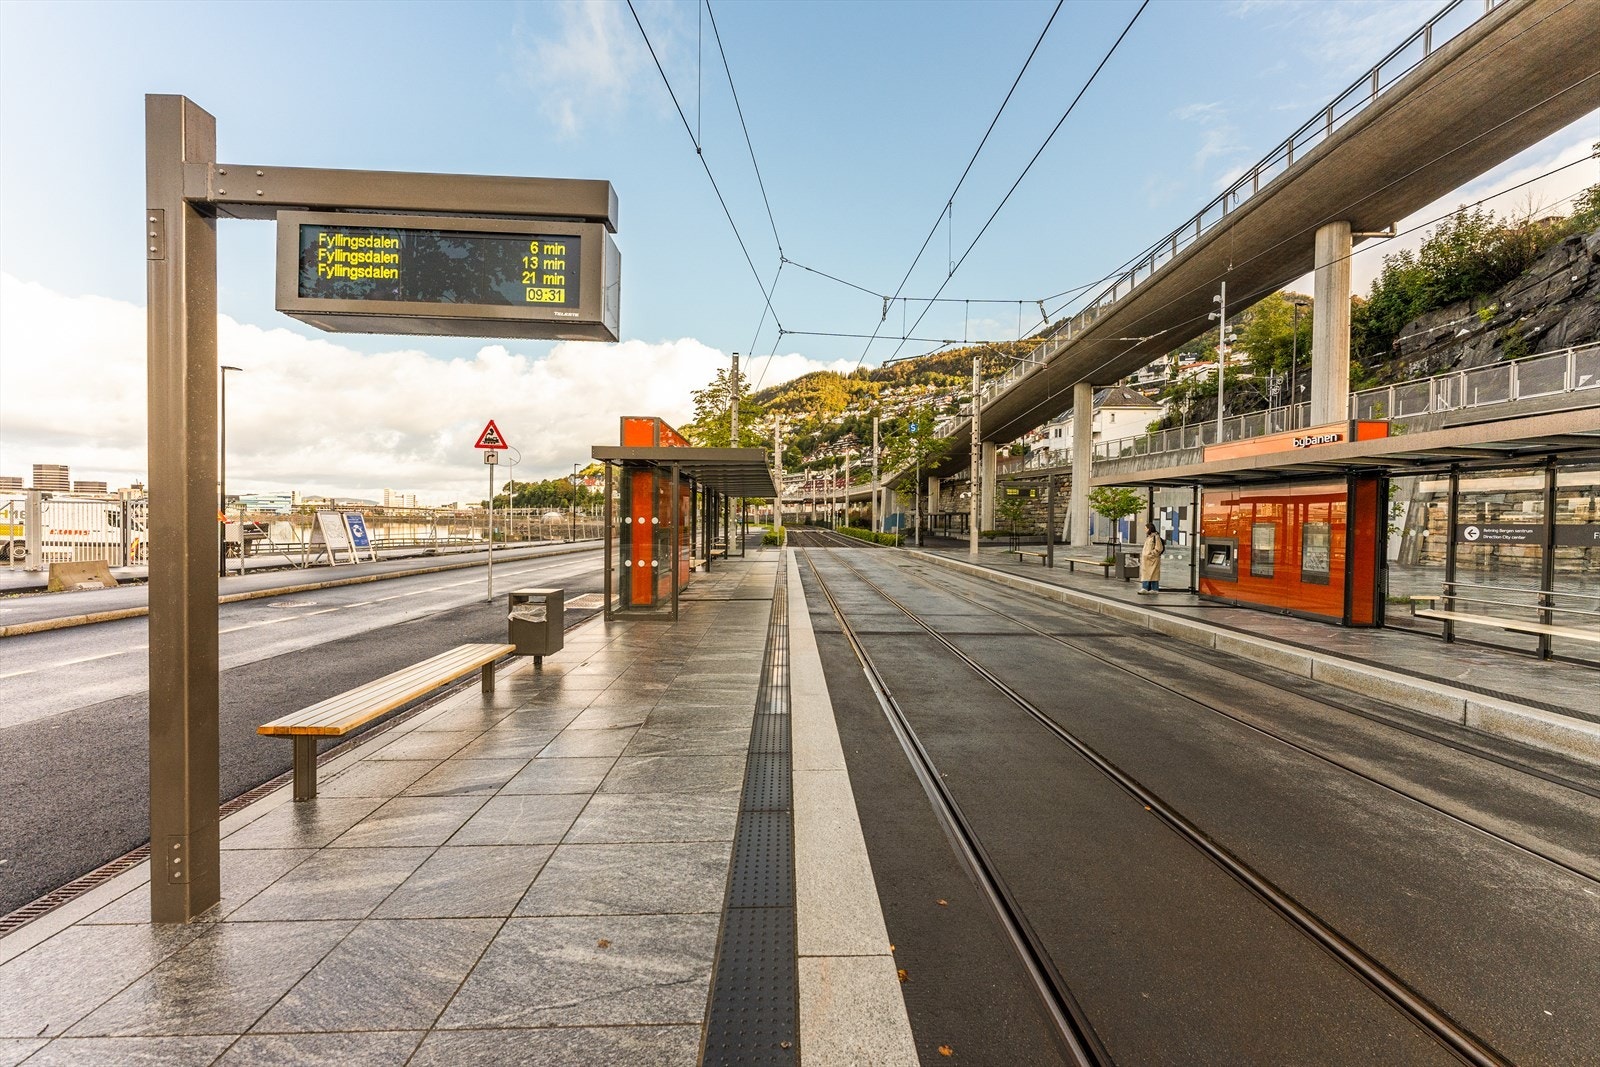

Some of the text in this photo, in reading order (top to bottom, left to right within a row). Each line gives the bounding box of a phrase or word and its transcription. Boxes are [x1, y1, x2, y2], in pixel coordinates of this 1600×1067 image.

[318, 232, 400, 250] Fyllingsdalen
[530, 241, 566, 256] 6 min
[318, 248, 399, 265] Fyllingsdalen
[522, 256, 566, 270] 13 min
[318, 263, 399, 280] Fyllingsdalen
[522, 271, 565, 286] 21 min
[527, 288, 562, 302] 09:31
[1293, 434, 1338, 448] bybanen
